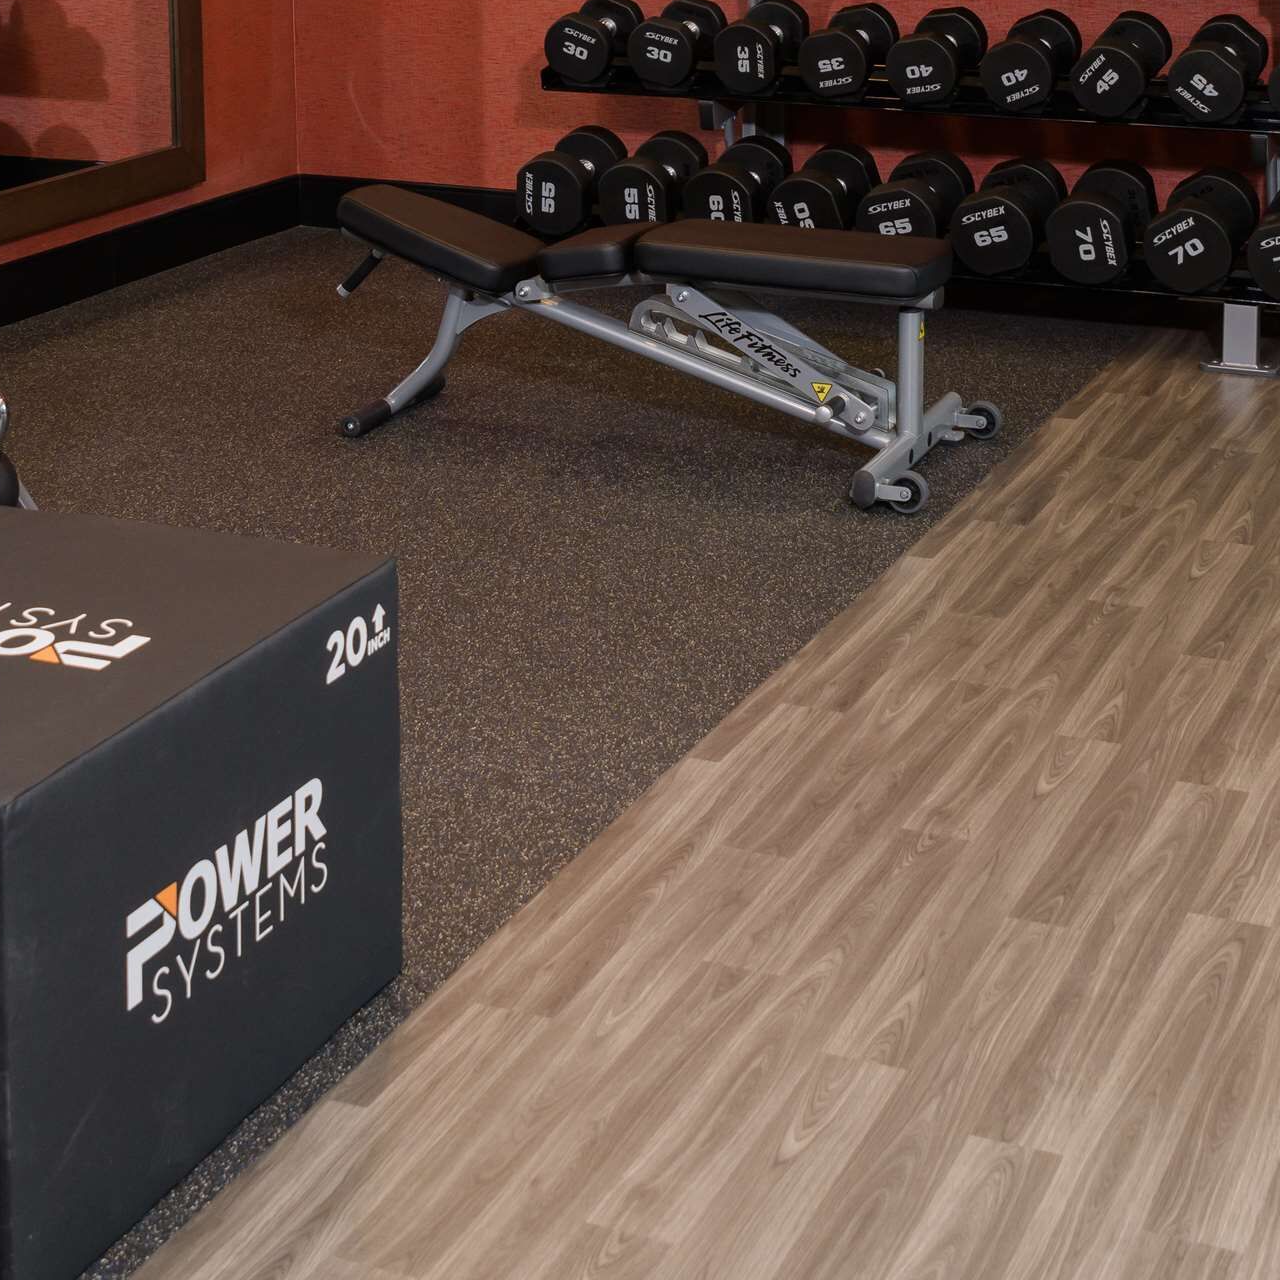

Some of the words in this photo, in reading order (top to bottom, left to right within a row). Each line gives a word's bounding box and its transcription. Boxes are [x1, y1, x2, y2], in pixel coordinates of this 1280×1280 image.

[572, 31, 597, 45] CYBEX
[654, 34, 680, 46] CYBEX
[562, 41, 589, 61] 30
[646, 46, 672, 63] 30
[737, 45, 750, 73] 35
[817, 57, 845, 73] 35
[905, 64, 933, 79] 40
[1000, 68, 1028, 87] 40
[1096, 69, 1119, 95] 45
[1190, 73, 1219, 97] 45
[541, 182, 556, 214] 55
[624, 187, 640, 219] 55
[882, 199, 911, 212] CYBEX
[774, 201, 789, 224] YBEX
[975, 206, 1005, 221] CYBEX
[879, 218, 912, 236] 65
[974, 226, 1009, 247] 65
[1075, 226, 1095, 261] 70
[1101, 232, 1118, 266] CYBEX
[1168, 238, 1205, 265] 70
[698, 311, 743, 336] Life
[733, 331, 802, 378] Fitness
[326, 616, 368, 685] 20
[367, 626, 391, 657] INCH
[126, 777, 327, 1011] POWER
[150, 842, 328, 1024] SYSTEMS
